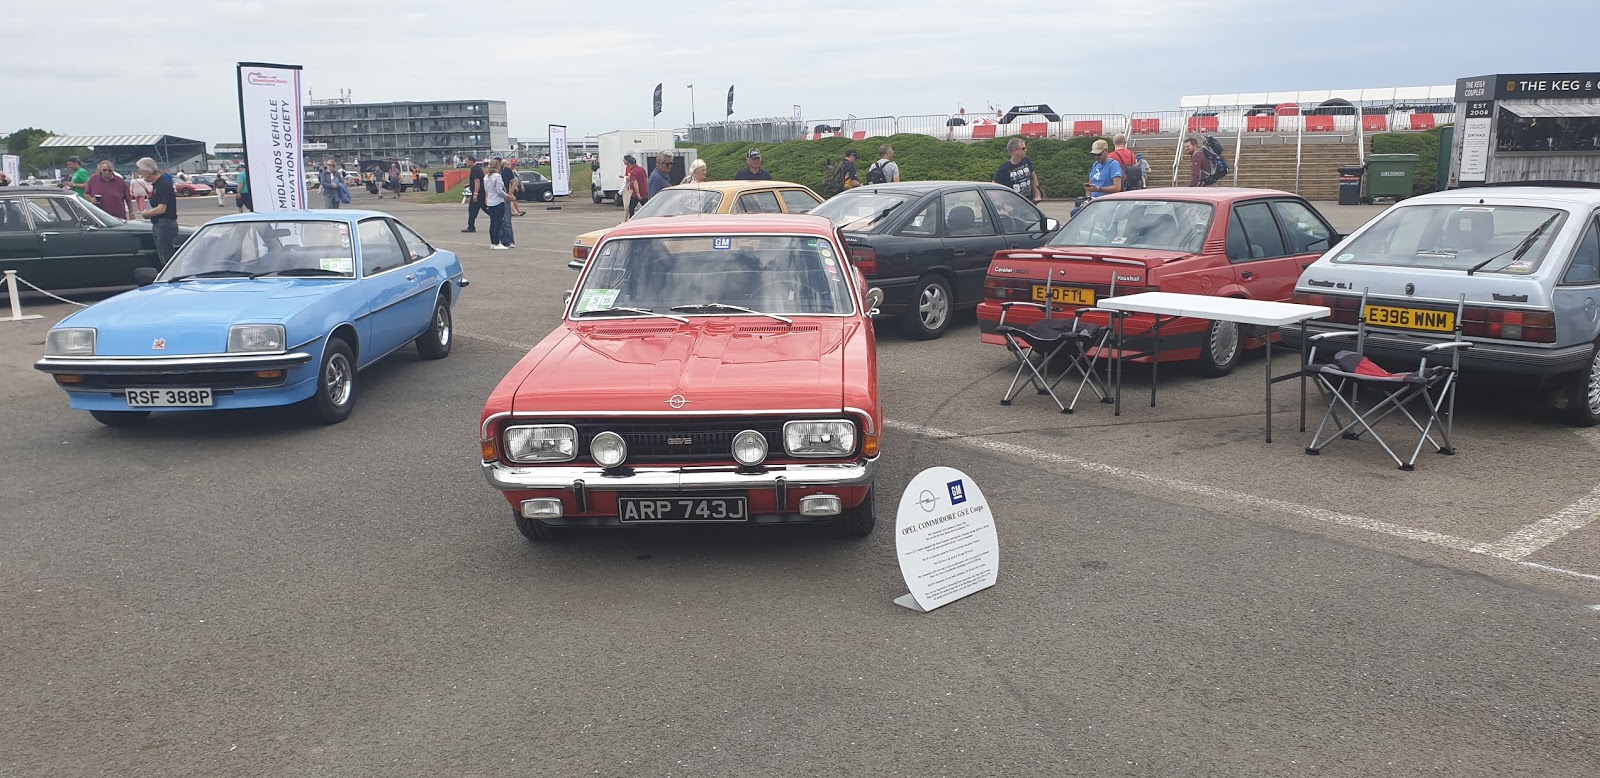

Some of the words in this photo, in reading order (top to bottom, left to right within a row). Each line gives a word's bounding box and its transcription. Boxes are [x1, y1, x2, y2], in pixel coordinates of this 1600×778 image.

[1464, 88, 1485, 97] COUPLER
[1519, 81, 1547, 91] THE
[1551, 80, 1580, 91] KEG
[1584, 80, 1592, 89] &
[269, 99, 281, 147] VEHICLE
[281, 99, 293, 149] SOCIETY
[273, 150, 287, 209] MIDLANDS
[715, 238, 730, 246] GM
[1117, 274, 1140, 282] Vauxhall
[1062, 289, 1087, 303] FTL
[1369, 307, 1410, 325] E396
[1414, 311, 1447, 329] WNM
[127, 390, 160, 404] RSF
[165, 390, 210, 404] 388P
[951, 484, 962, 496] GM
[624, 500, 672, 520] ARP
[678, 500, 744, 520] 743J
[901, 525, 919, 536] OPEL
[918, 512, 957, 531] COMMODORE
[957, 508, 970, 518] GS/E
